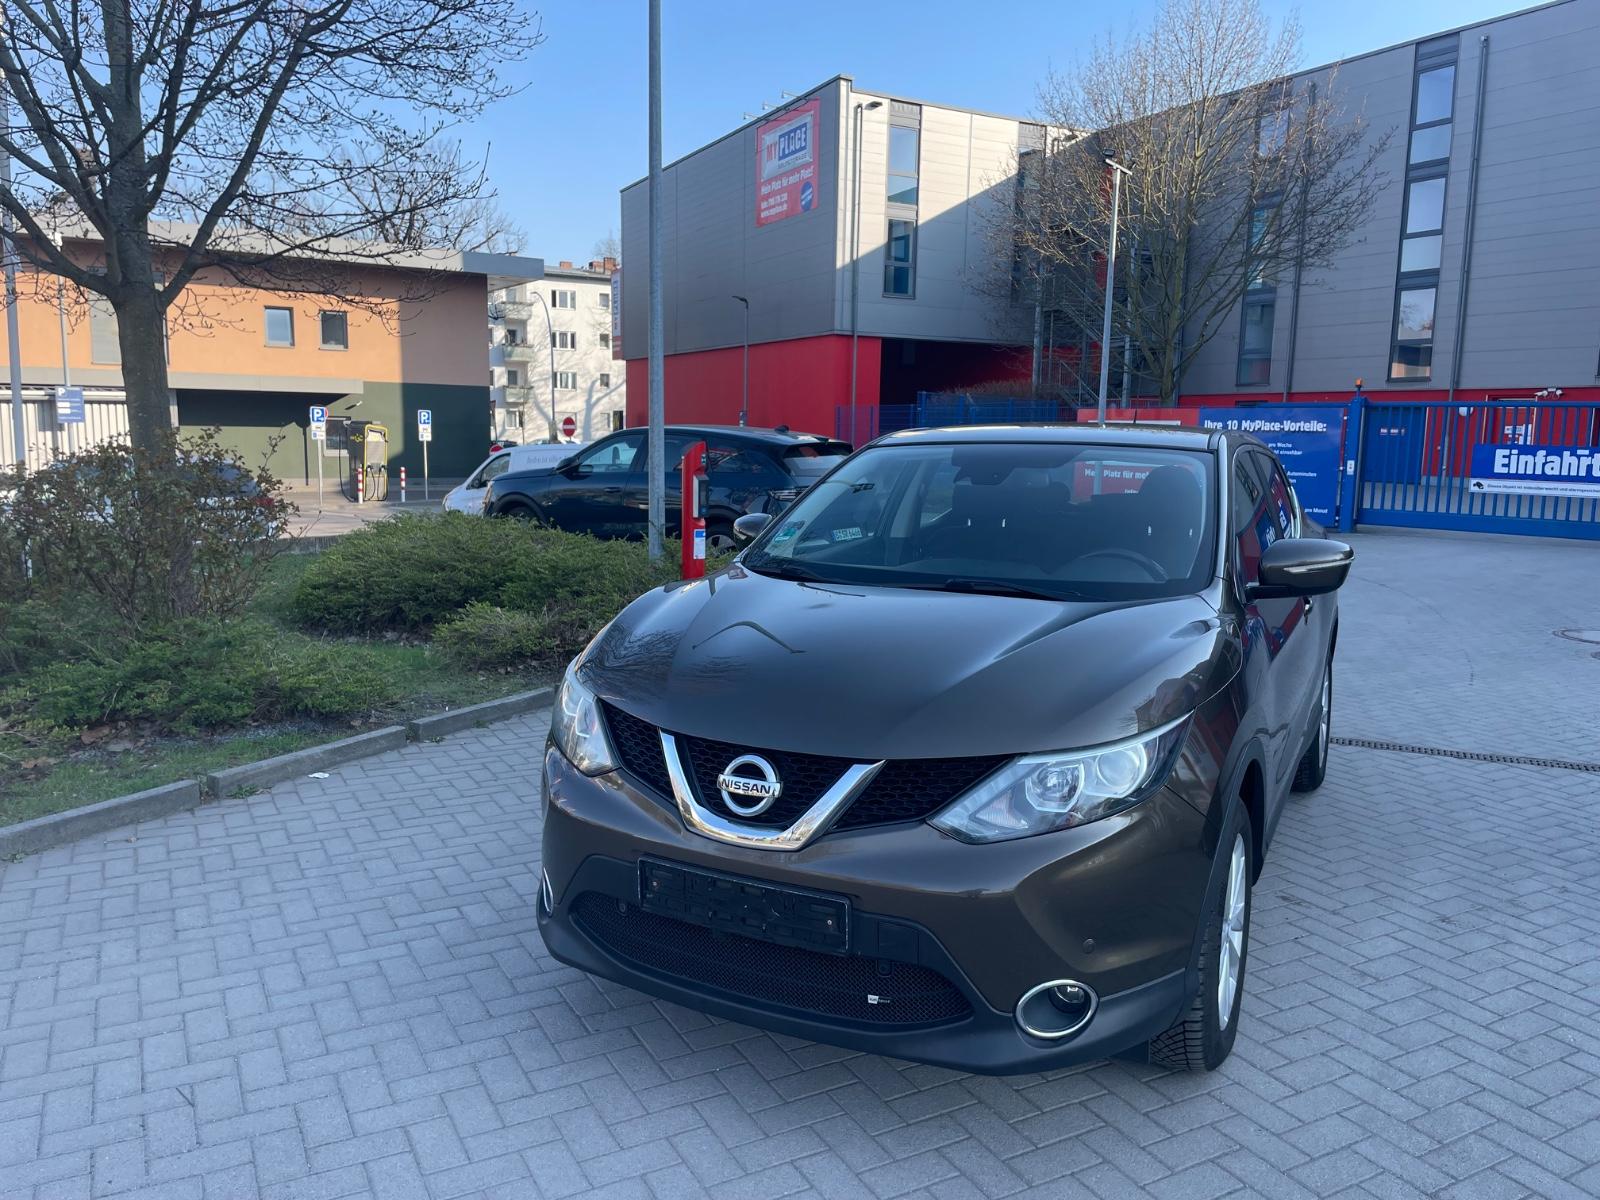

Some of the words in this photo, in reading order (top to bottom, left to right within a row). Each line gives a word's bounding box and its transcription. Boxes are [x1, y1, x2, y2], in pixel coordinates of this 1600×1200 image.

[766, 141, 778, 162] MY
[779, 127, 806, 157] PLACE
[1204, 419, 1223, 430] Ihre
[1226, 419, 1238, 431] 10
[1241, 420, 1327, 432] MyPlace-Vorteile:
[1493, 449, 1600, 477] Einfahrt
[1103, 469, 1121, 478] Platz
[1122, 470, 1134, 479] für
[721, 778, 772, 795] NISSAN
